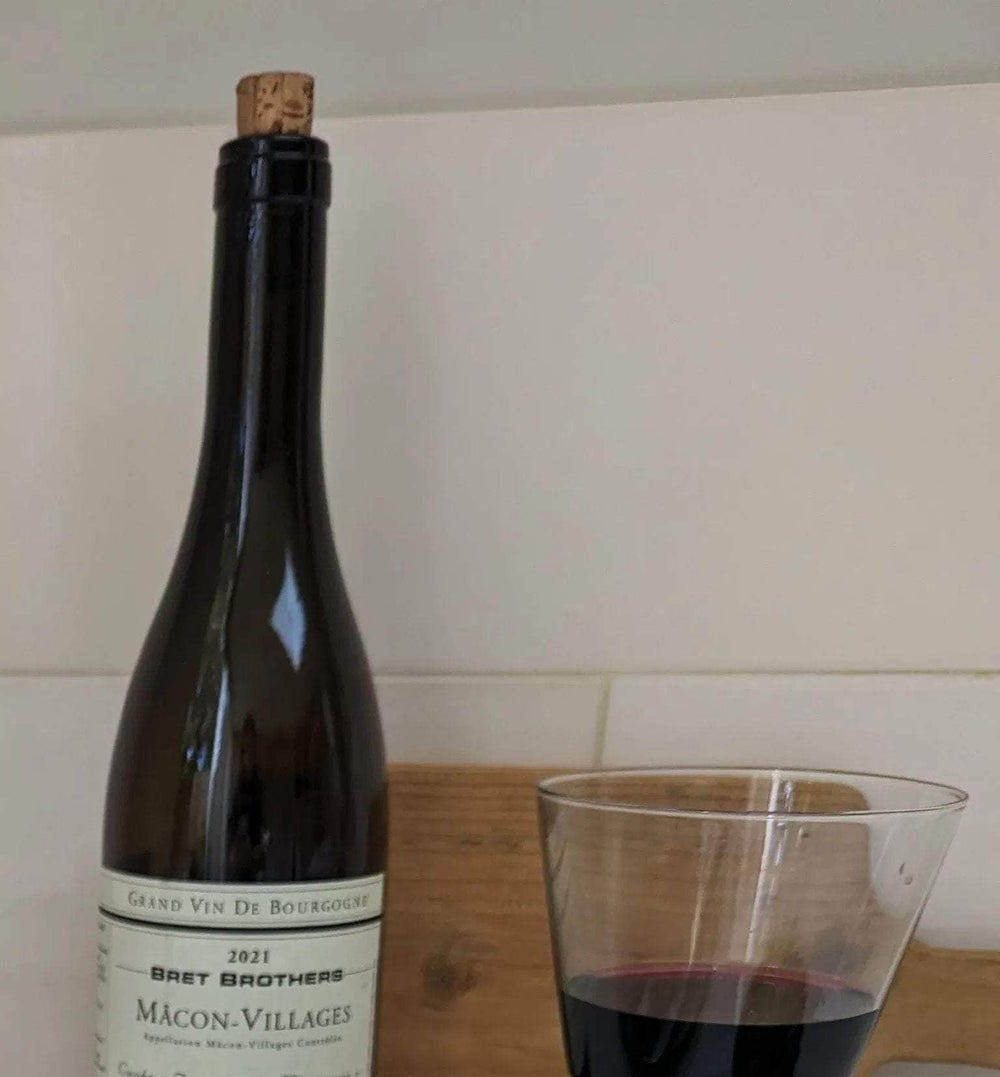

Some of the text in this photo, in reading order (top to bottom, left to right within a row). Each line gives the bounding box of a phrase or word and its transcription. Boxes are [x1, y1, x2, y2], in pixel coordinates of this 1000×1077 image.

[127, 890, 369, 915] GRAND VIN DE BOURGOGNE
[227, 950, 269, 964] 2021
[151, 966, 343, 987] BRET BROTHERS
[136, 998, 351, 1031] MÂCON-VILLAGES
